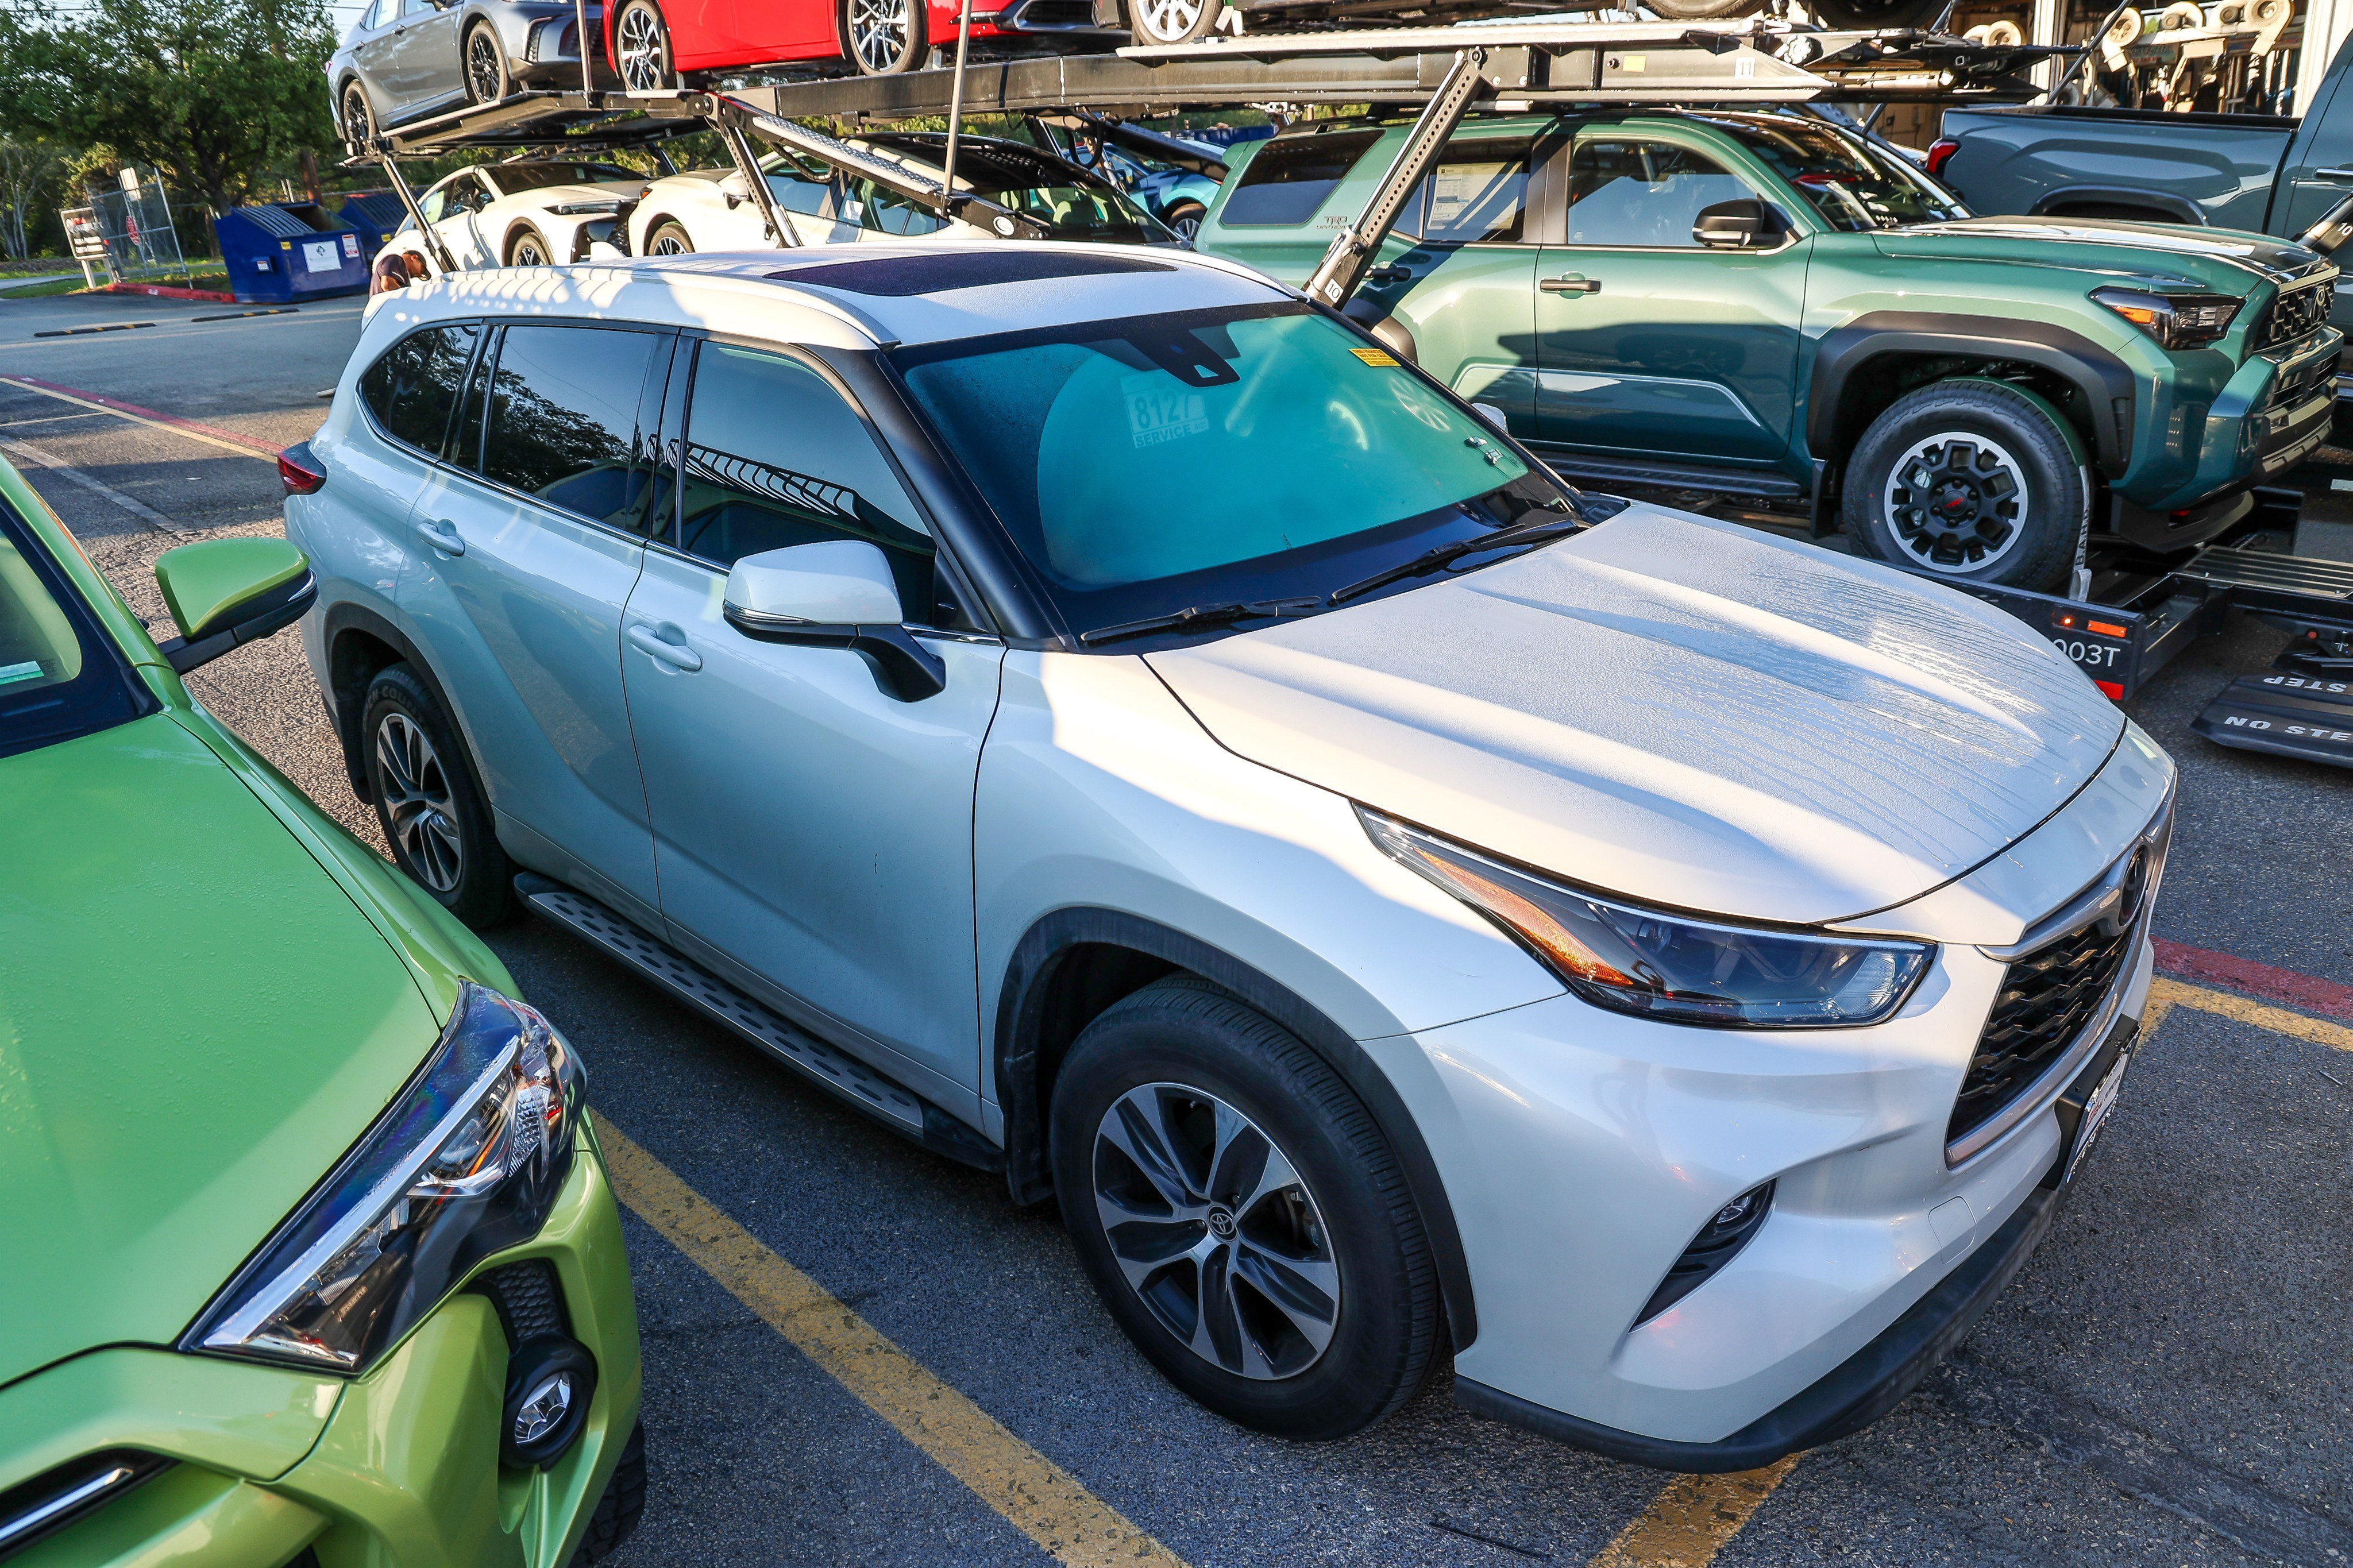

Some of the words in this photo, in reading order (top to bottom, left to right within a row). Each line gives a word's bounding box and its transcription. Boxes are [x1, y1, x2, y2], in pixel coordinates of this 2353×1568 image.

[1739, 61, 1752, 75] 11
[1324, 215, 1348, 225] TRD
[2337, 222, 2353, 236] 10
[1329, 283, 1340, 299] 10
[1135, 424, 1192, 447] SERVICE
[2263, 676, 2347, 693] STEP
[2223, 716, 2271, 729] NO
[2284, 725, 2353, 741] STE
